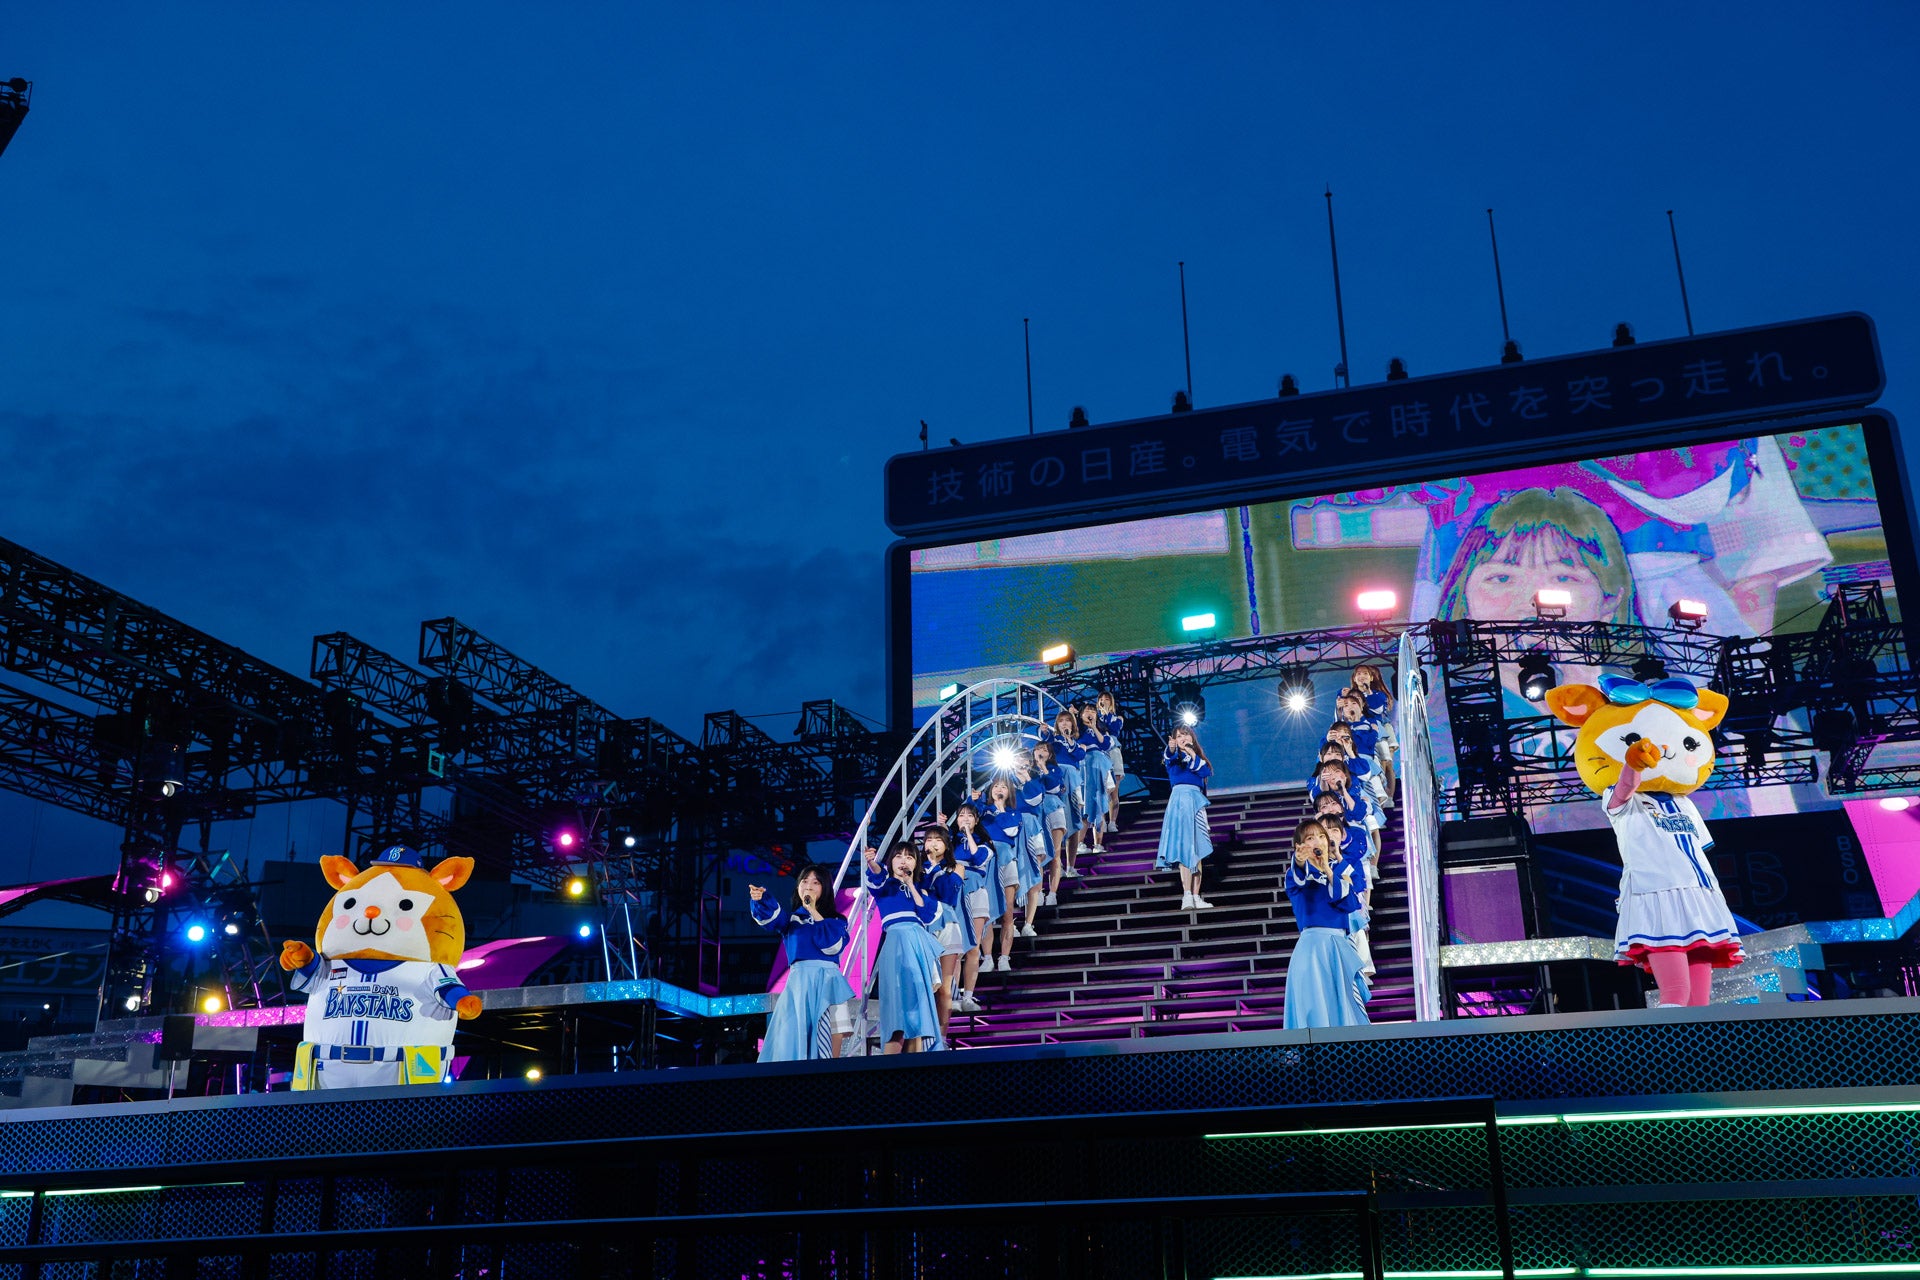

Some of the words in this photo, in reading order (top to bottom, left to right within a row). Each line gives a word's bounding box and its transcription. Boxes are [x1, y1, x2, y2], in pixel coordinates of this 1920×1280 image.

[928, 350, 1830, 506] 技術の日産。電気で時代を突っ走れ。
[323, 985, 414, 1022] BAYSTARS
[372, 984, 399, 996] DeNA
